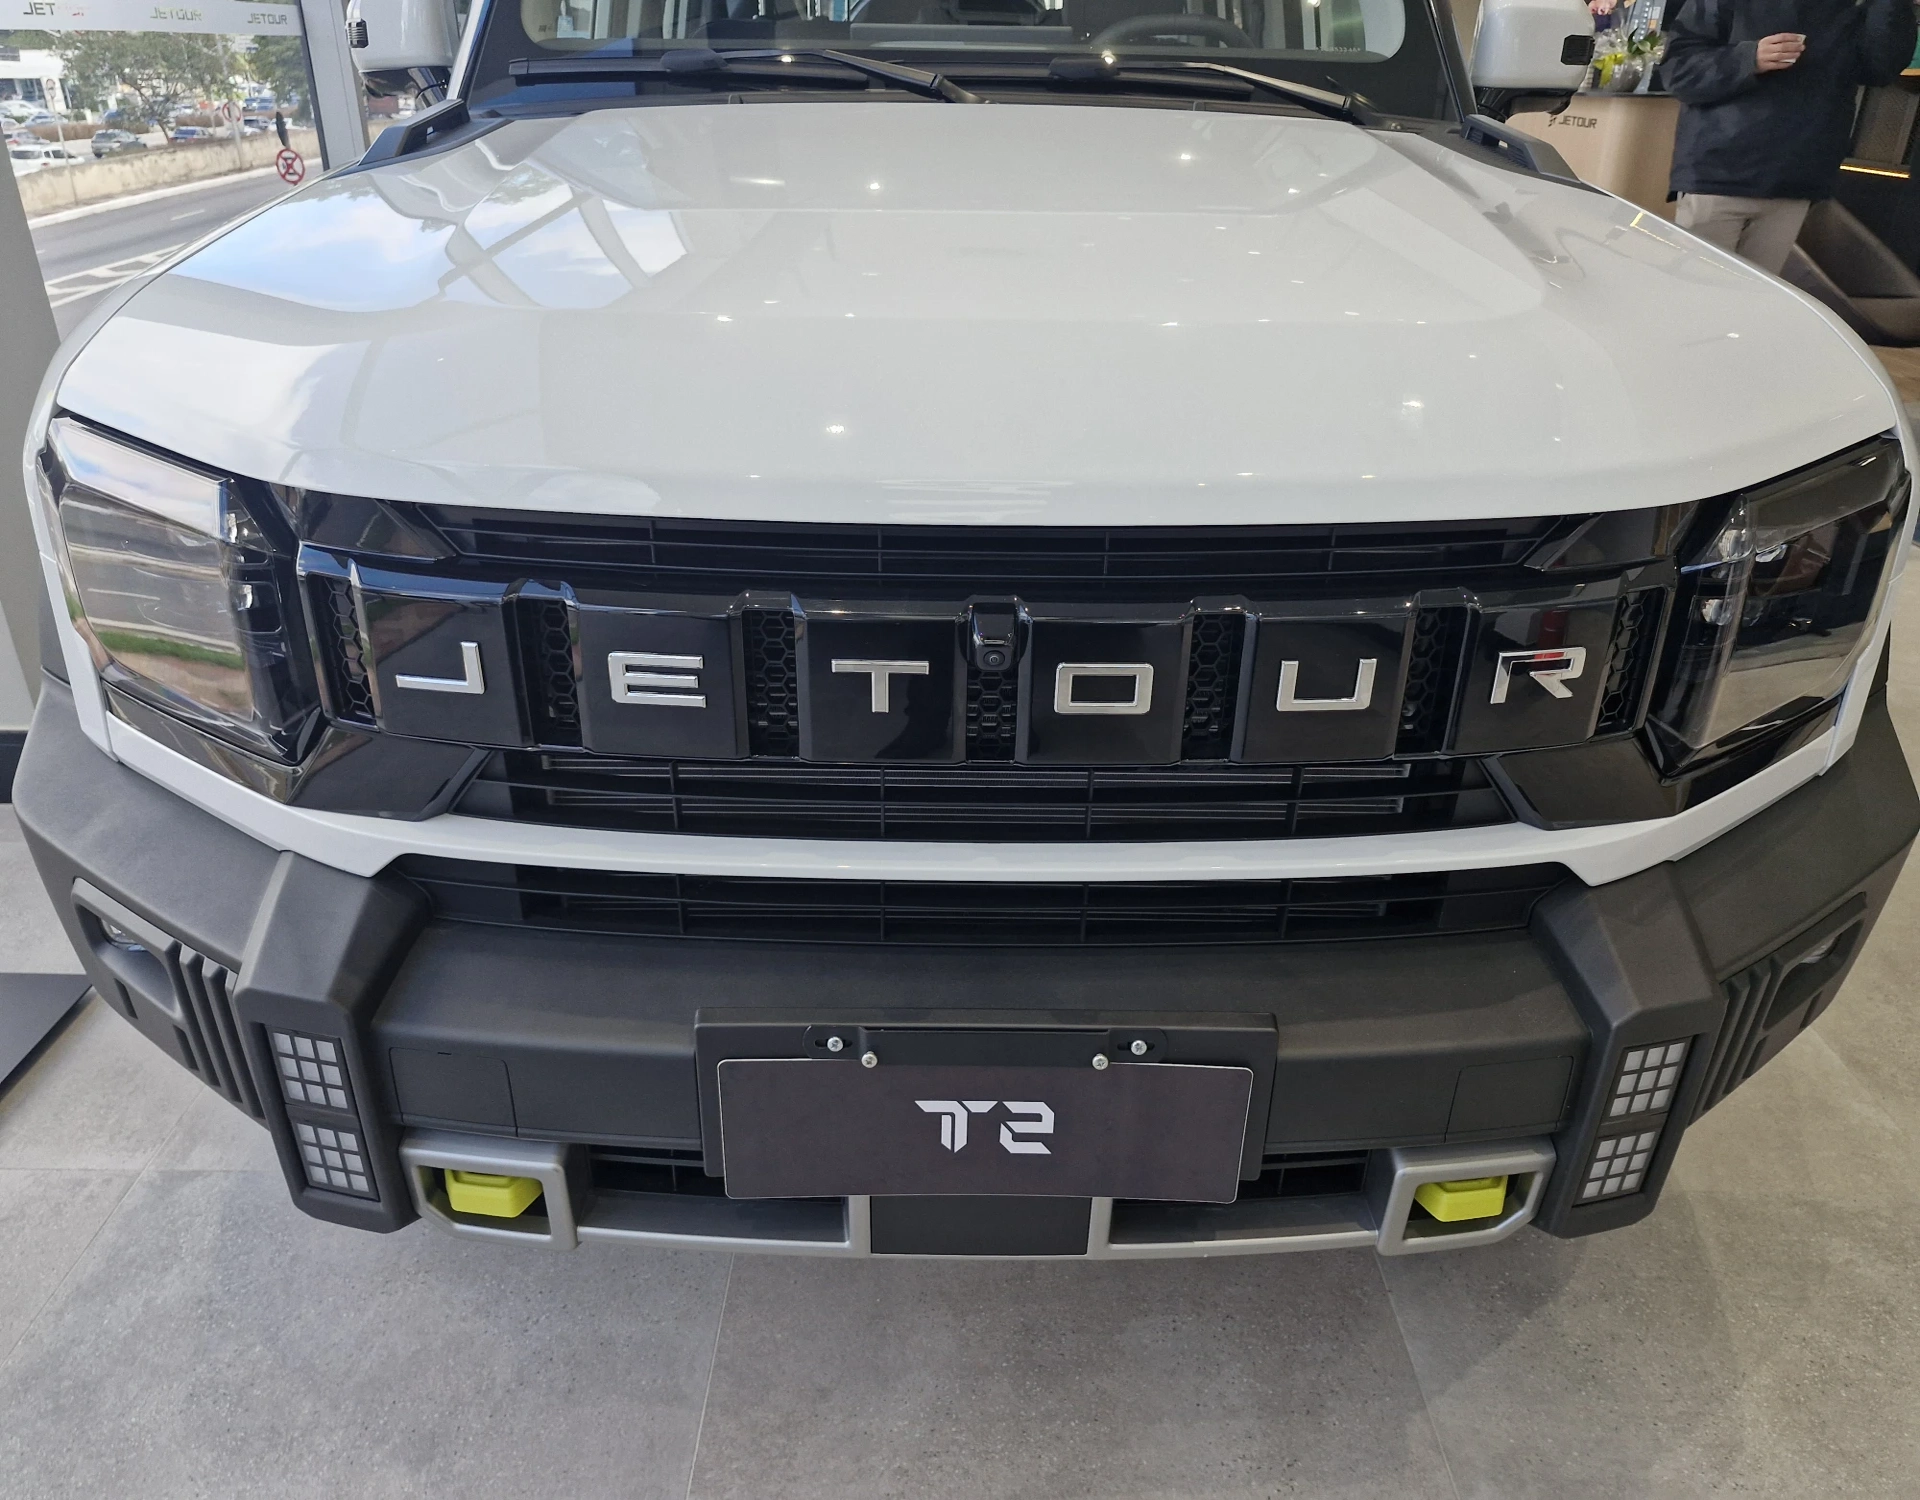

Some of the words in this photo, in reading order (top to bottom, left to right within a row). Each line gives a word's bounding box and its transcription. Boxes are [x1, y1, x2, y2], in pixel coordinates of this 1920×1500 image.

[150, 6, 203, 21] JETOUR
[247, 12, 289, 25] JETOUR
[1559, 115, 1598, 129] JETOUR
[395, 640, 1587, 716] JETOUR
[914, 1100, 1055, 1155] T2
